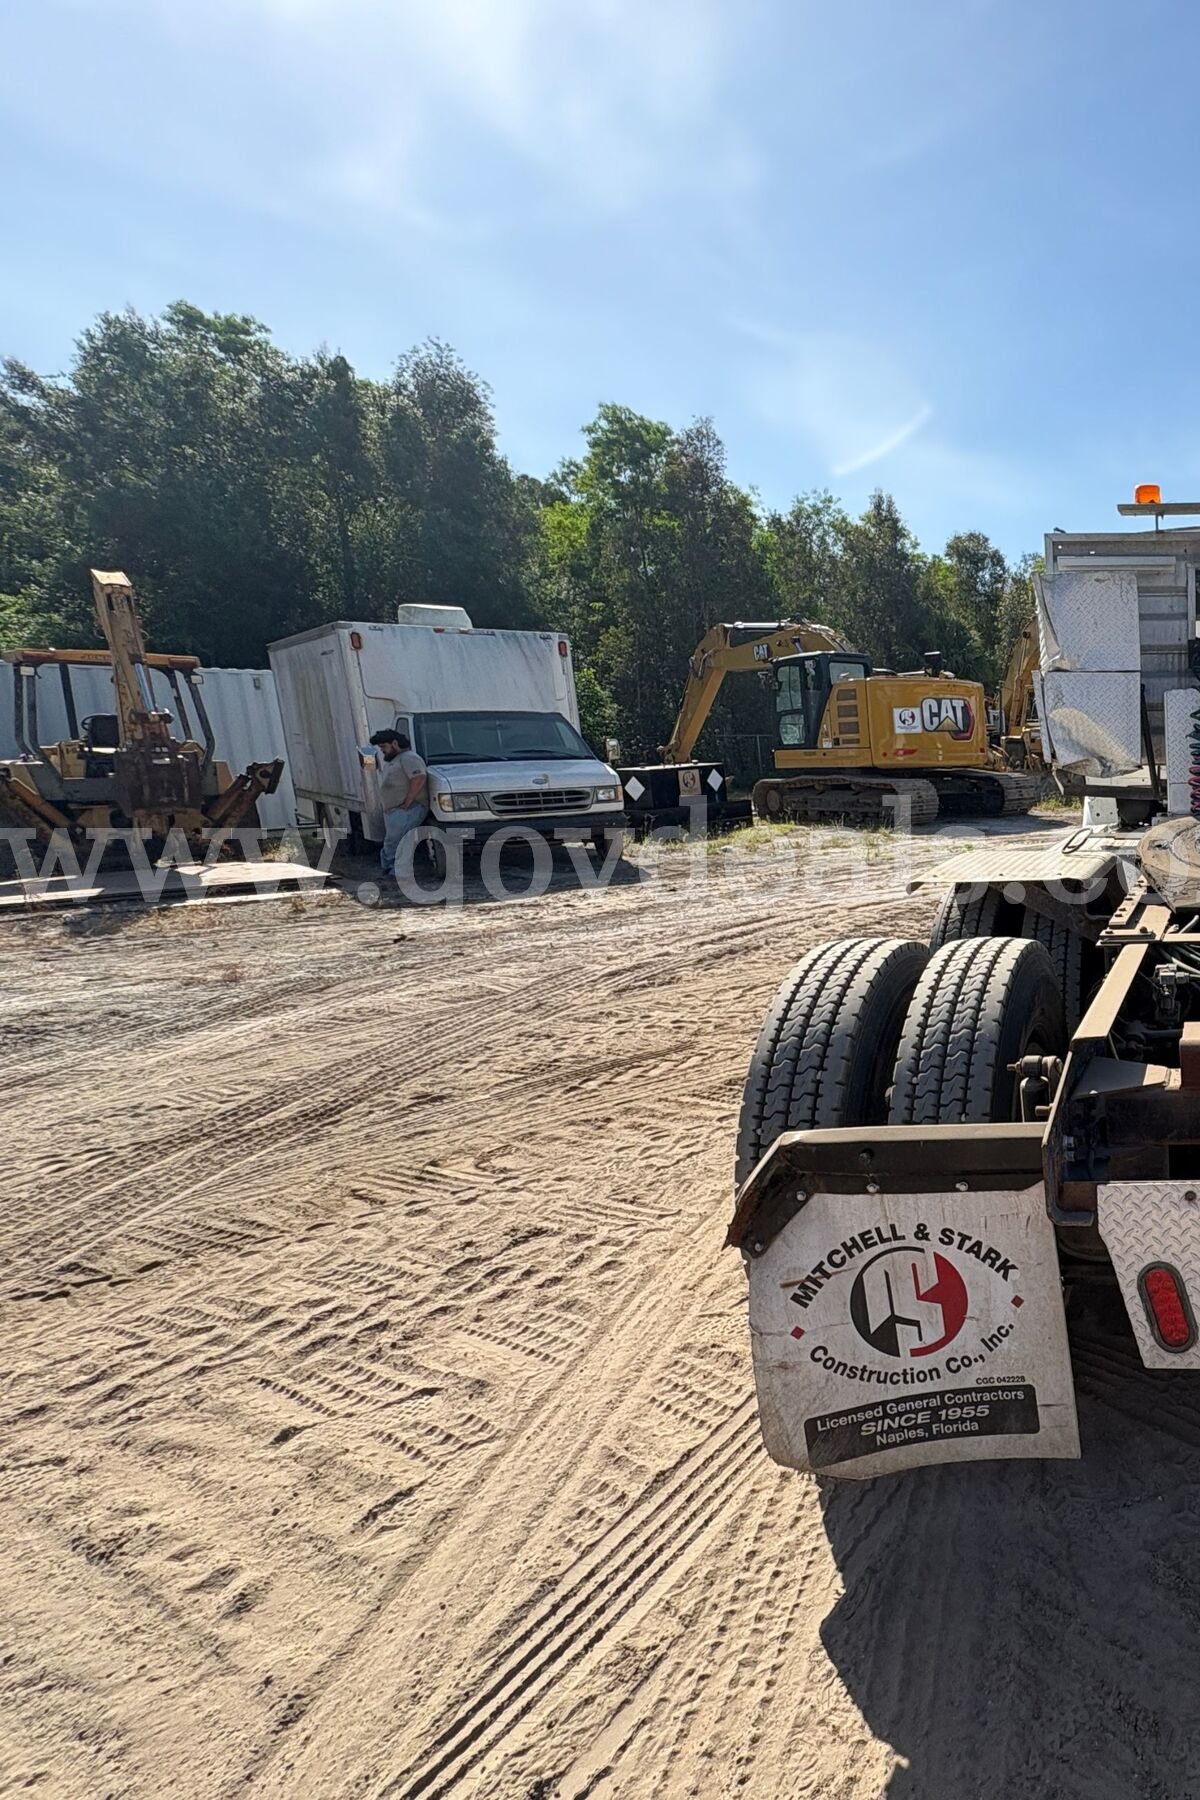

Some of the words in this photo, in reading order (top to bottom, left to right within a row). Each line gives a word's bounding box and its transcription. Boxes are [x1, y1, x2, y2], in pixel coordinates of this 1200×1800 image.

[753, 644, 769, 660] CAT
[922, 697, 965, 732] CAT
[790, 1224, 906, 1309] MITCHELL
[914, 1223, 931, 1241] &
[938, 1228, 1019, 1282] STARK
[810, 1345, 941, 1385] Construction
[946, 1353, 985, 1374] Co.,
[980, 1323, 1015, 1352] Inc.
[816, 1405, 883, 1432] Licensed
[886, 1396, 941, 1415] General
[944, 1389, 1025, 1405] Contractors
[860, 1411, 931, 1436] SINCE
[938, 1404, 990, 1421] 1955
[876, 1429, 929, 1447] Naples,
[932, 1420, 979, 1435] Florida
